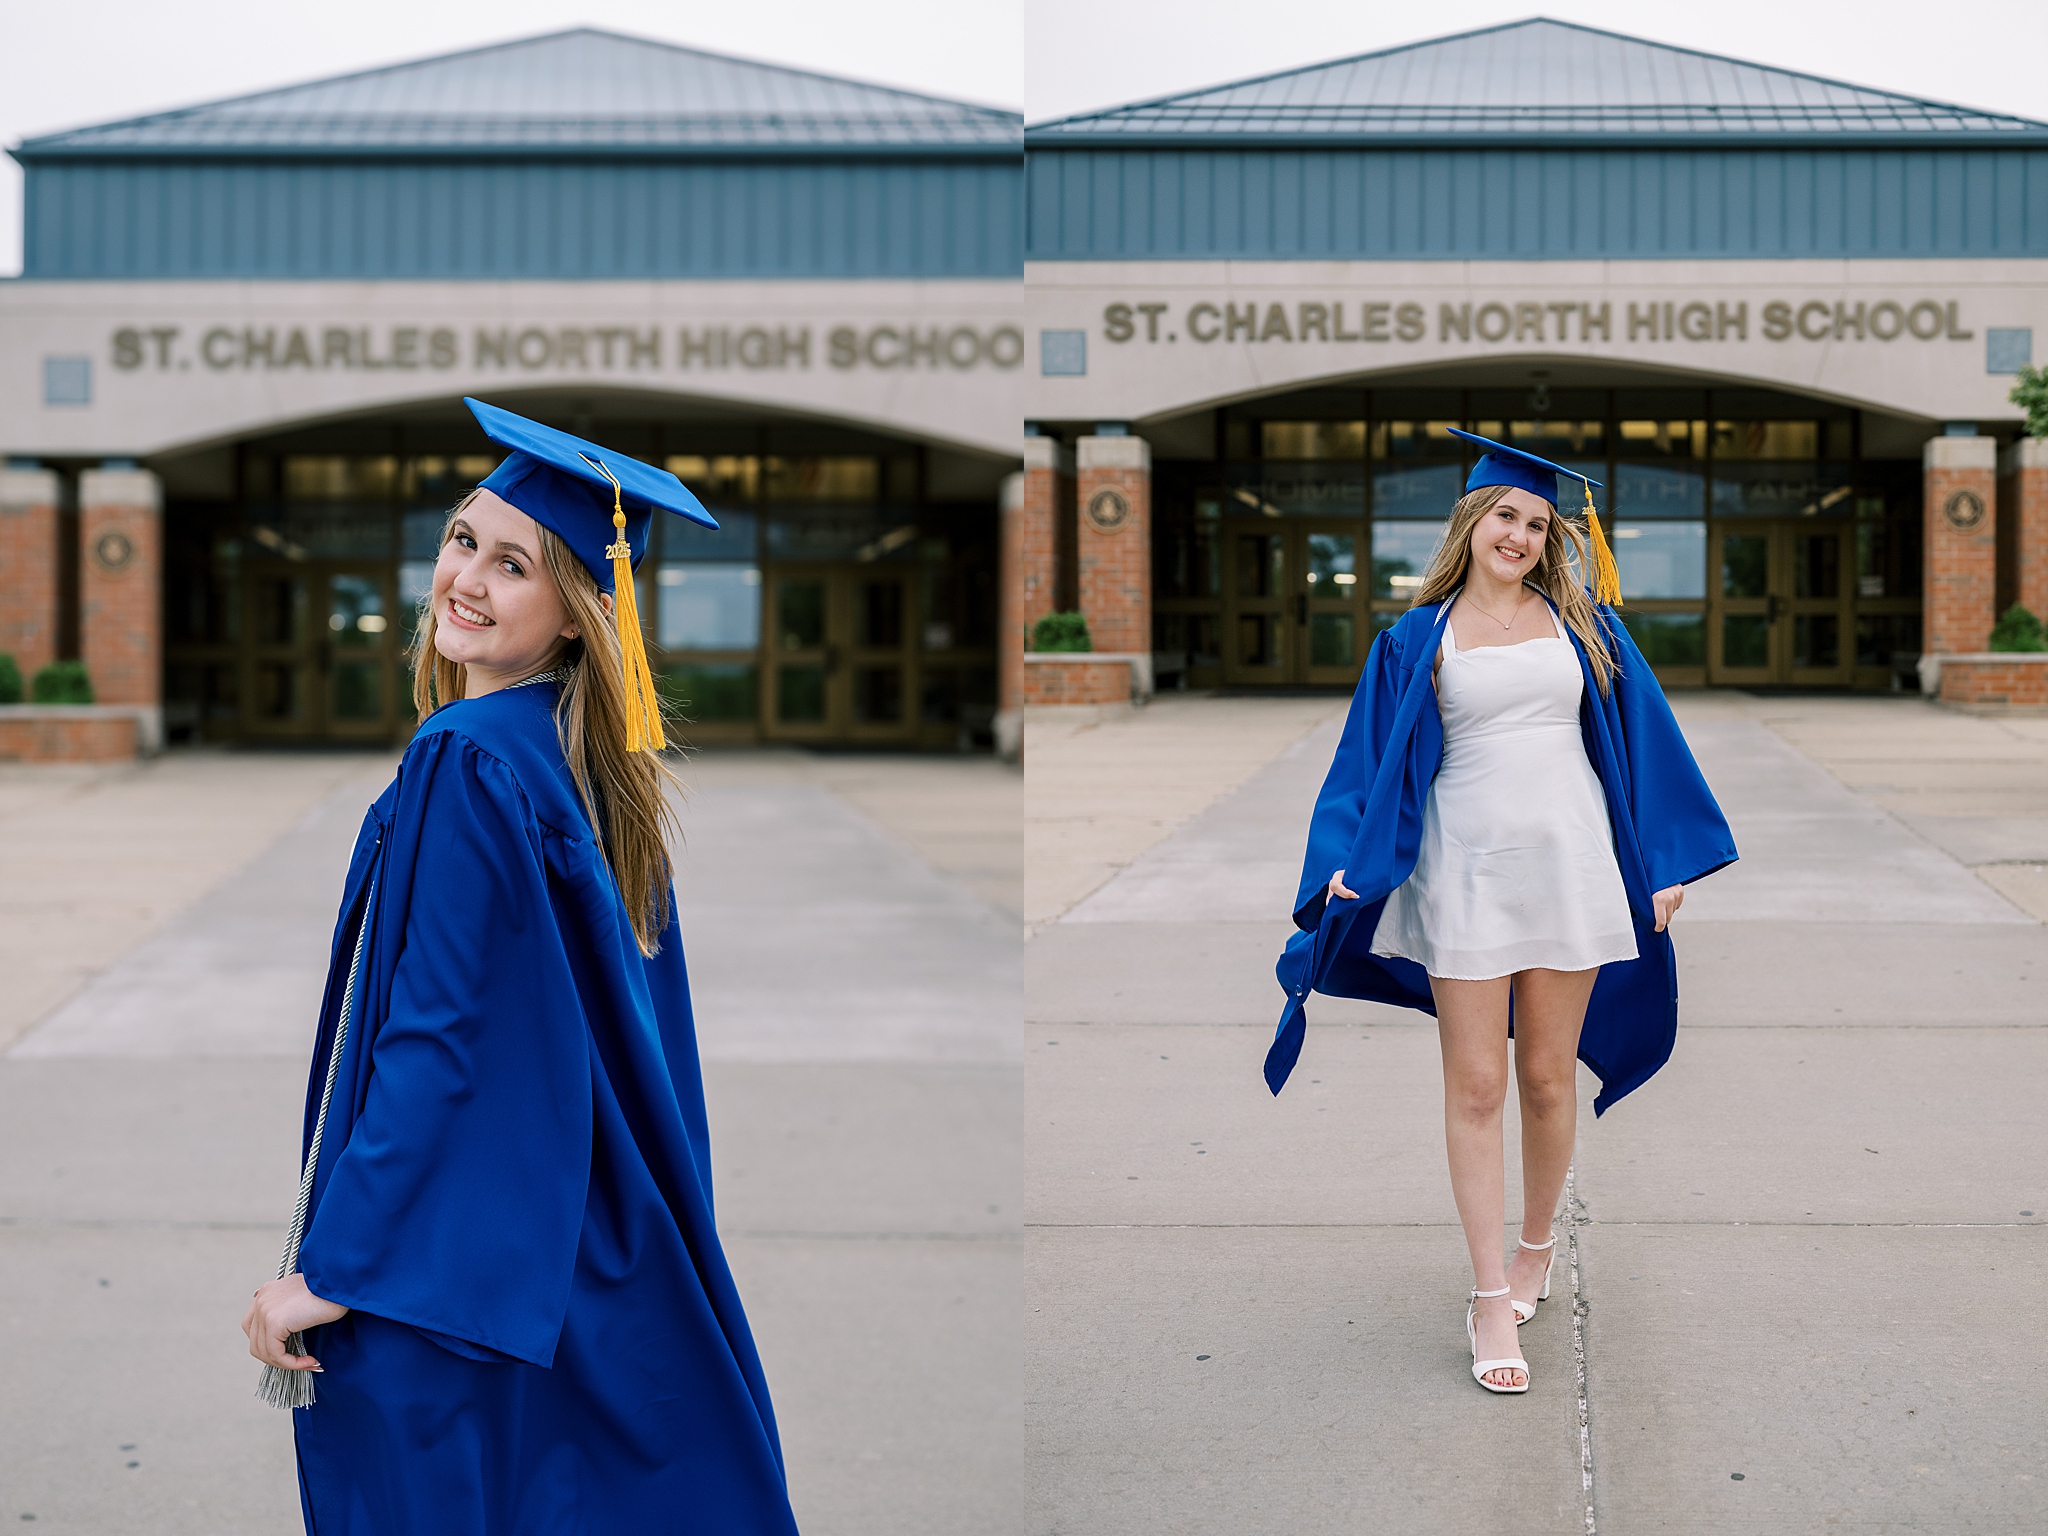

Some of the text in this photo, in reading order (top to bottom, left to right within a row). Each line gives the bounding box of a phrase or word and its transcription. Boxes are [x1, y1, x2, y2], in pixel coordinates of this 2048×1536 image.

[1103, 300, 1974, 343] ST. CHARLES NORTH HIGH SCHOOL
[112, 327, 190, 371] ST.
[202, 327, 458, 371] CHARLES
[474, 327, 660, 371] NORTH
[680, 327, 811, 371] HIGH
[605, 543, 632, 560] 2025
